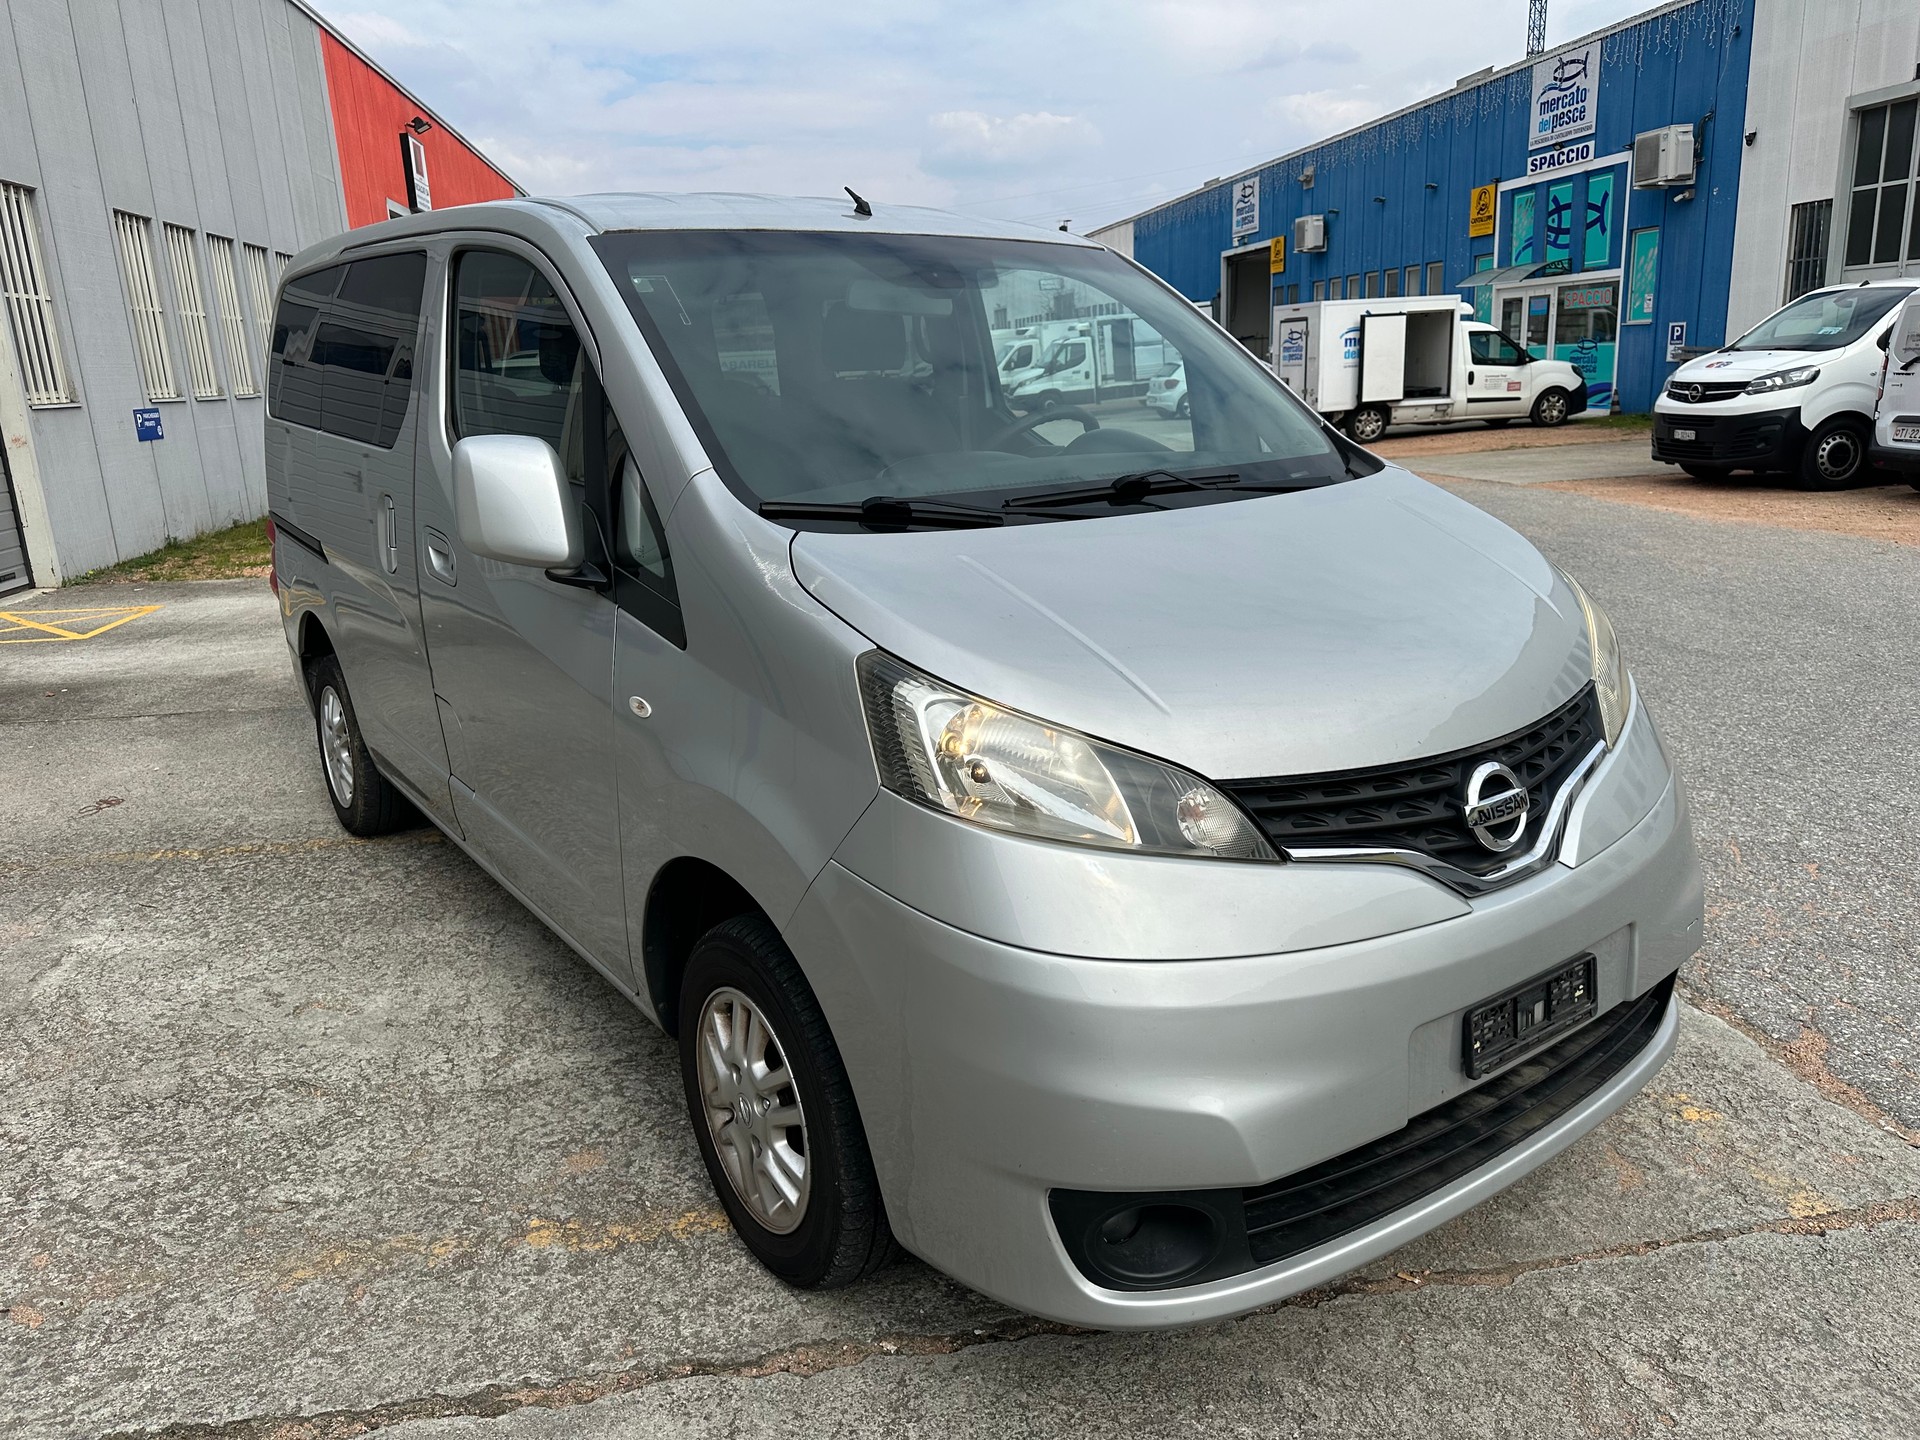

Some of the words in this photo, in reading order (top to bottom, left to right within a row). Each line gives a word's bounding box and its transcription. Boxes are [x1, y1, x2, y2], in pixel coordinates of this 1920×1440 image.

[1539, 85, 1587, 116] mercato
[1530, 144, 1590, 173] SPACCIO
[1565, 288, 1611, 308] SPACCIO
[1673, 326, 1681, 340] P
[136, 413, 143, 428] P
[1478, 793, 1528, 822] NISSAN
